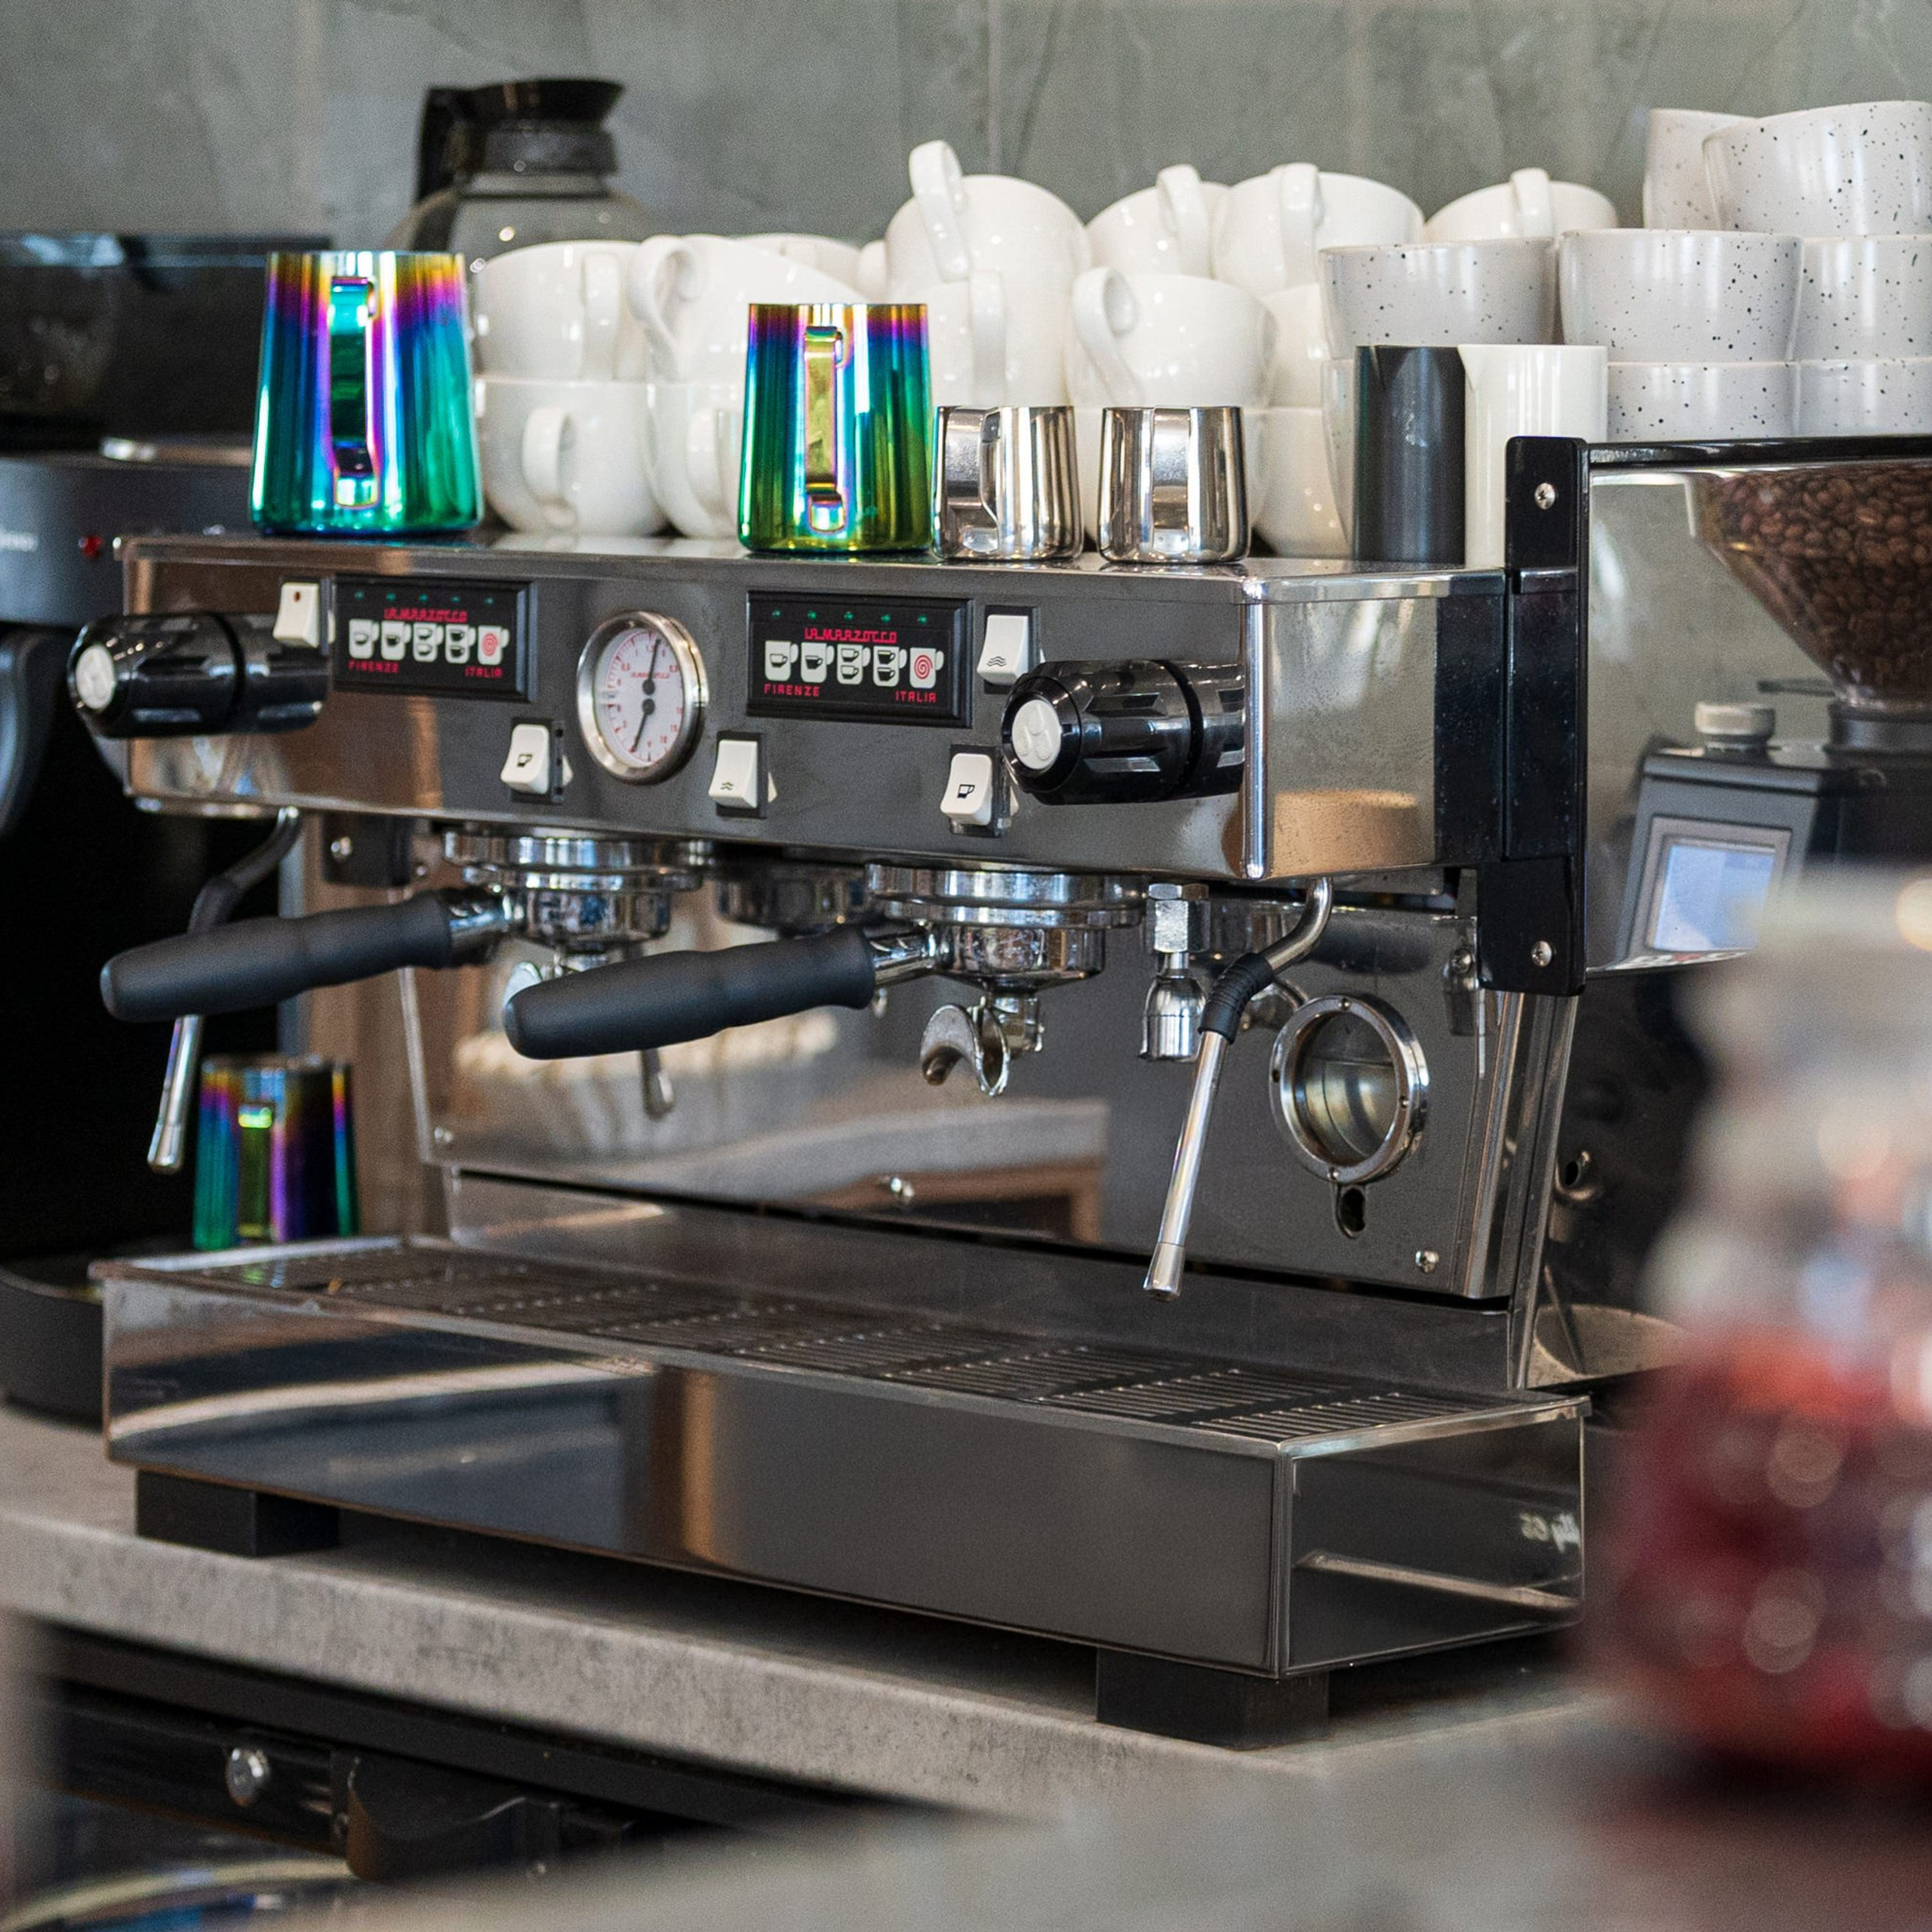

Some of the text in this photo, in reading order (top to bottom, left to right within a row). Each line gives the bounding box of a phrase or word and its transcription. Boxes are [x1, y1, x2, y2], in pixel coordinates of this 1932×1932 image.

[348, 660, 399, 674] FIRENZE
[465, 666, 503, 678] ITALIA
[764, 683, 820, 697] FIRENZE
[895, 691, 937, 703] ITALIA
